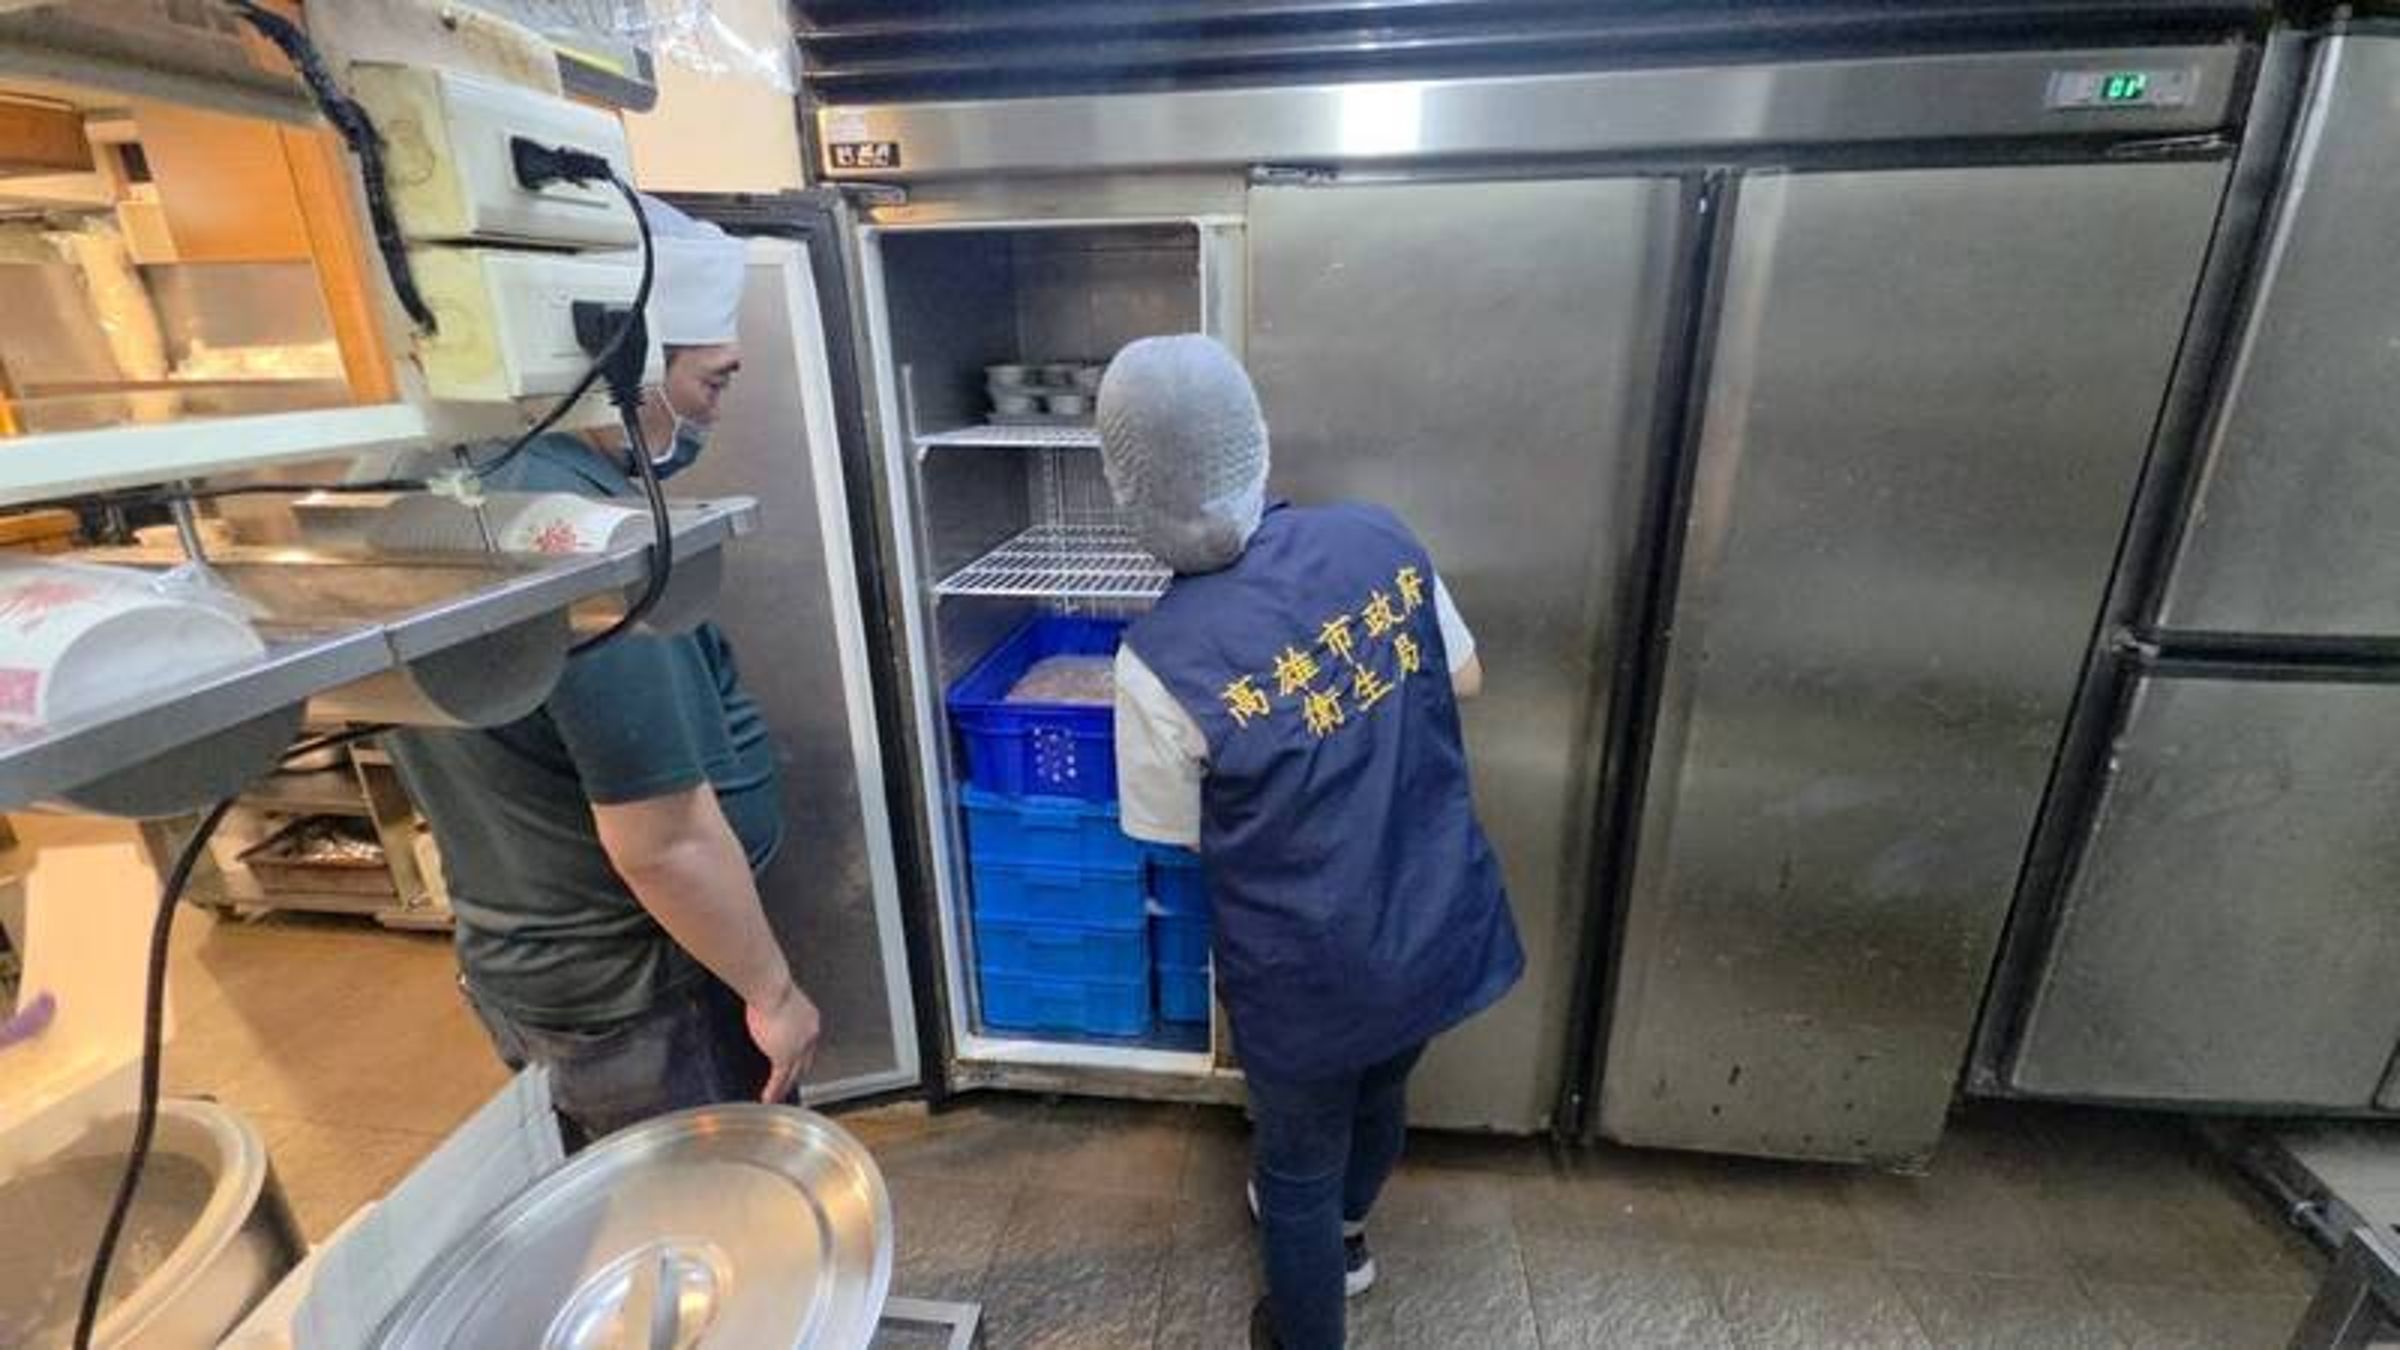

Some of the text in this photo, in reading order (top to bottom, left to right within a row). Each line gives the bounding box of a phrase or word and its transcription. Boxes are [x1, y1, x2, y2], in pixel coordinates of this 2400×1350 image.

[1221, 567, 1422, 728] 高雄市政府
[1304, 633, 1420, 737] 衛生局
